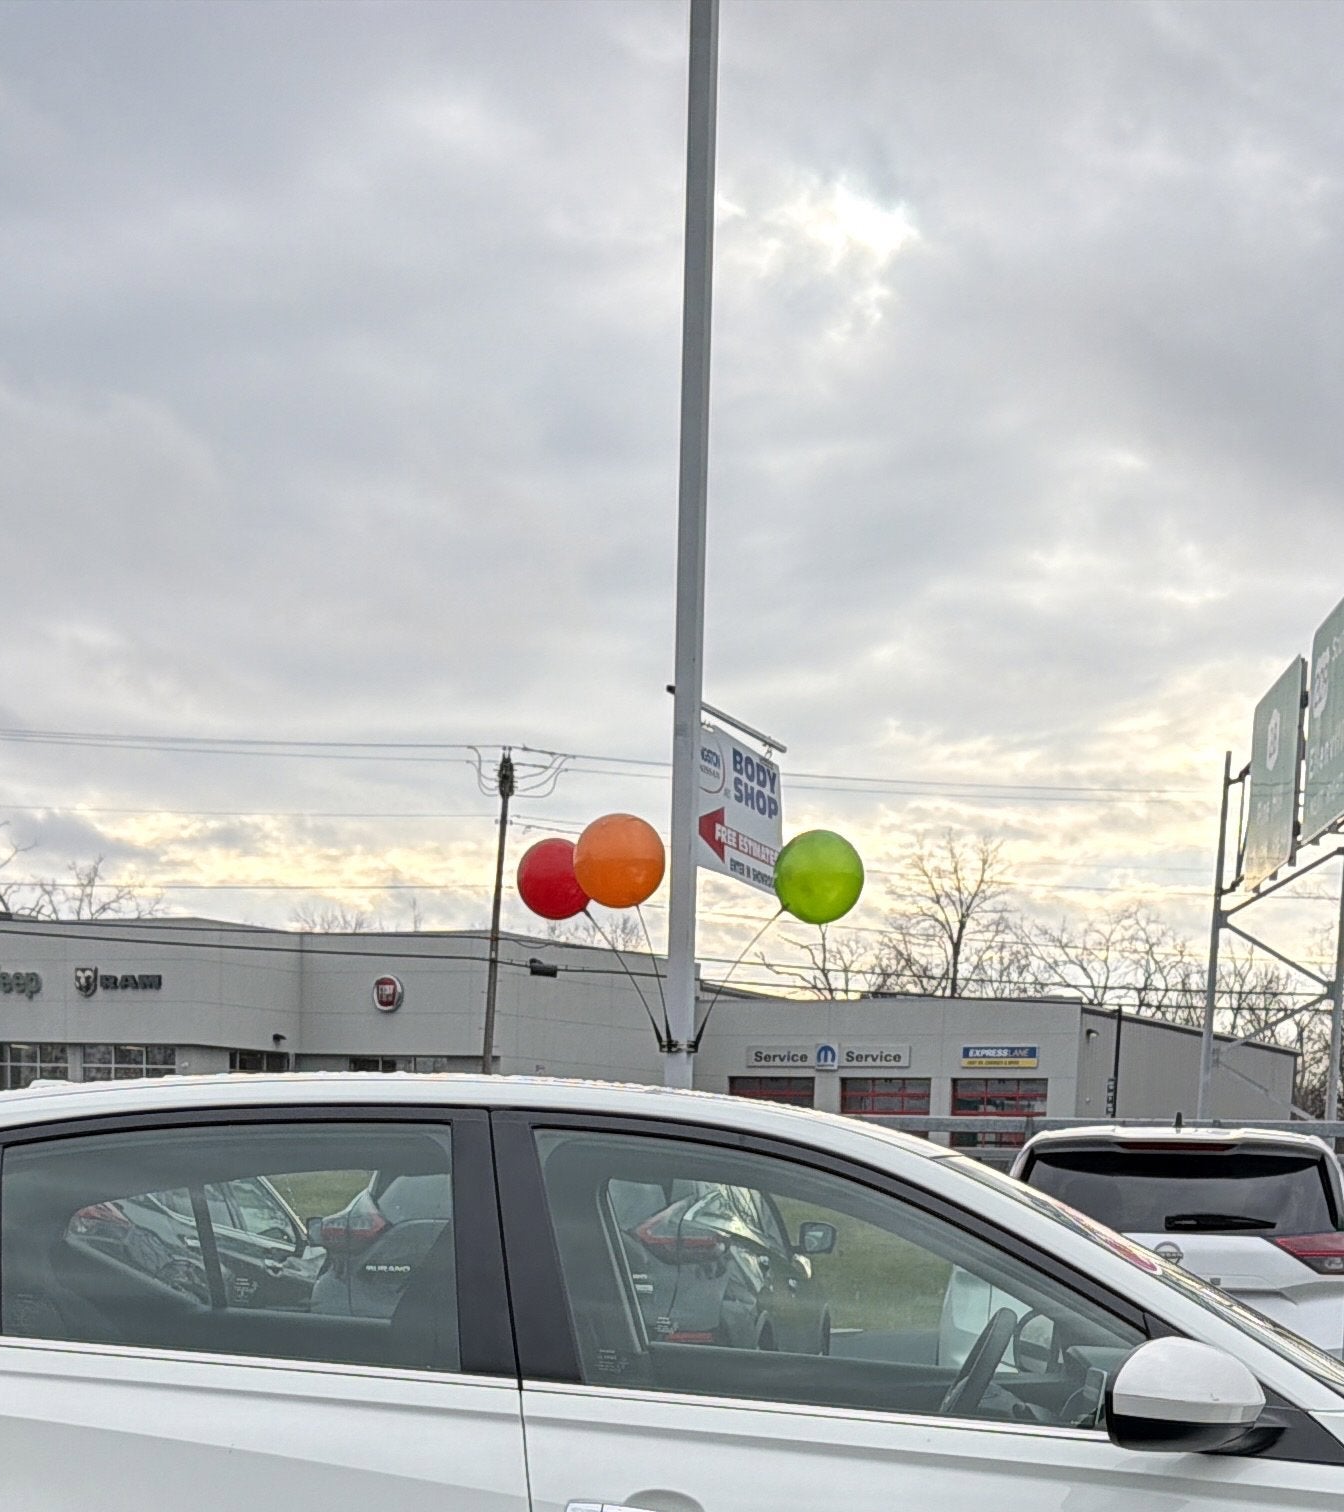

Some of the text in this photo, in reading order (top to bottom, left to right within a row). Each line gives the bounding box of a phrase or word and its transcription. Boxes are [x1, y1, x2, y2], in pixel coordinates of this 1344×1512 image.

[732, 747, 777, 796] BODY
[733, 776, 779, 819] SHOP
[715, 823, 737, 848] FREE
[99, 974, 162, 990] RAM
[754, 1051, 808, 1062] Service
[845, 1051, 902, 1062] Service
